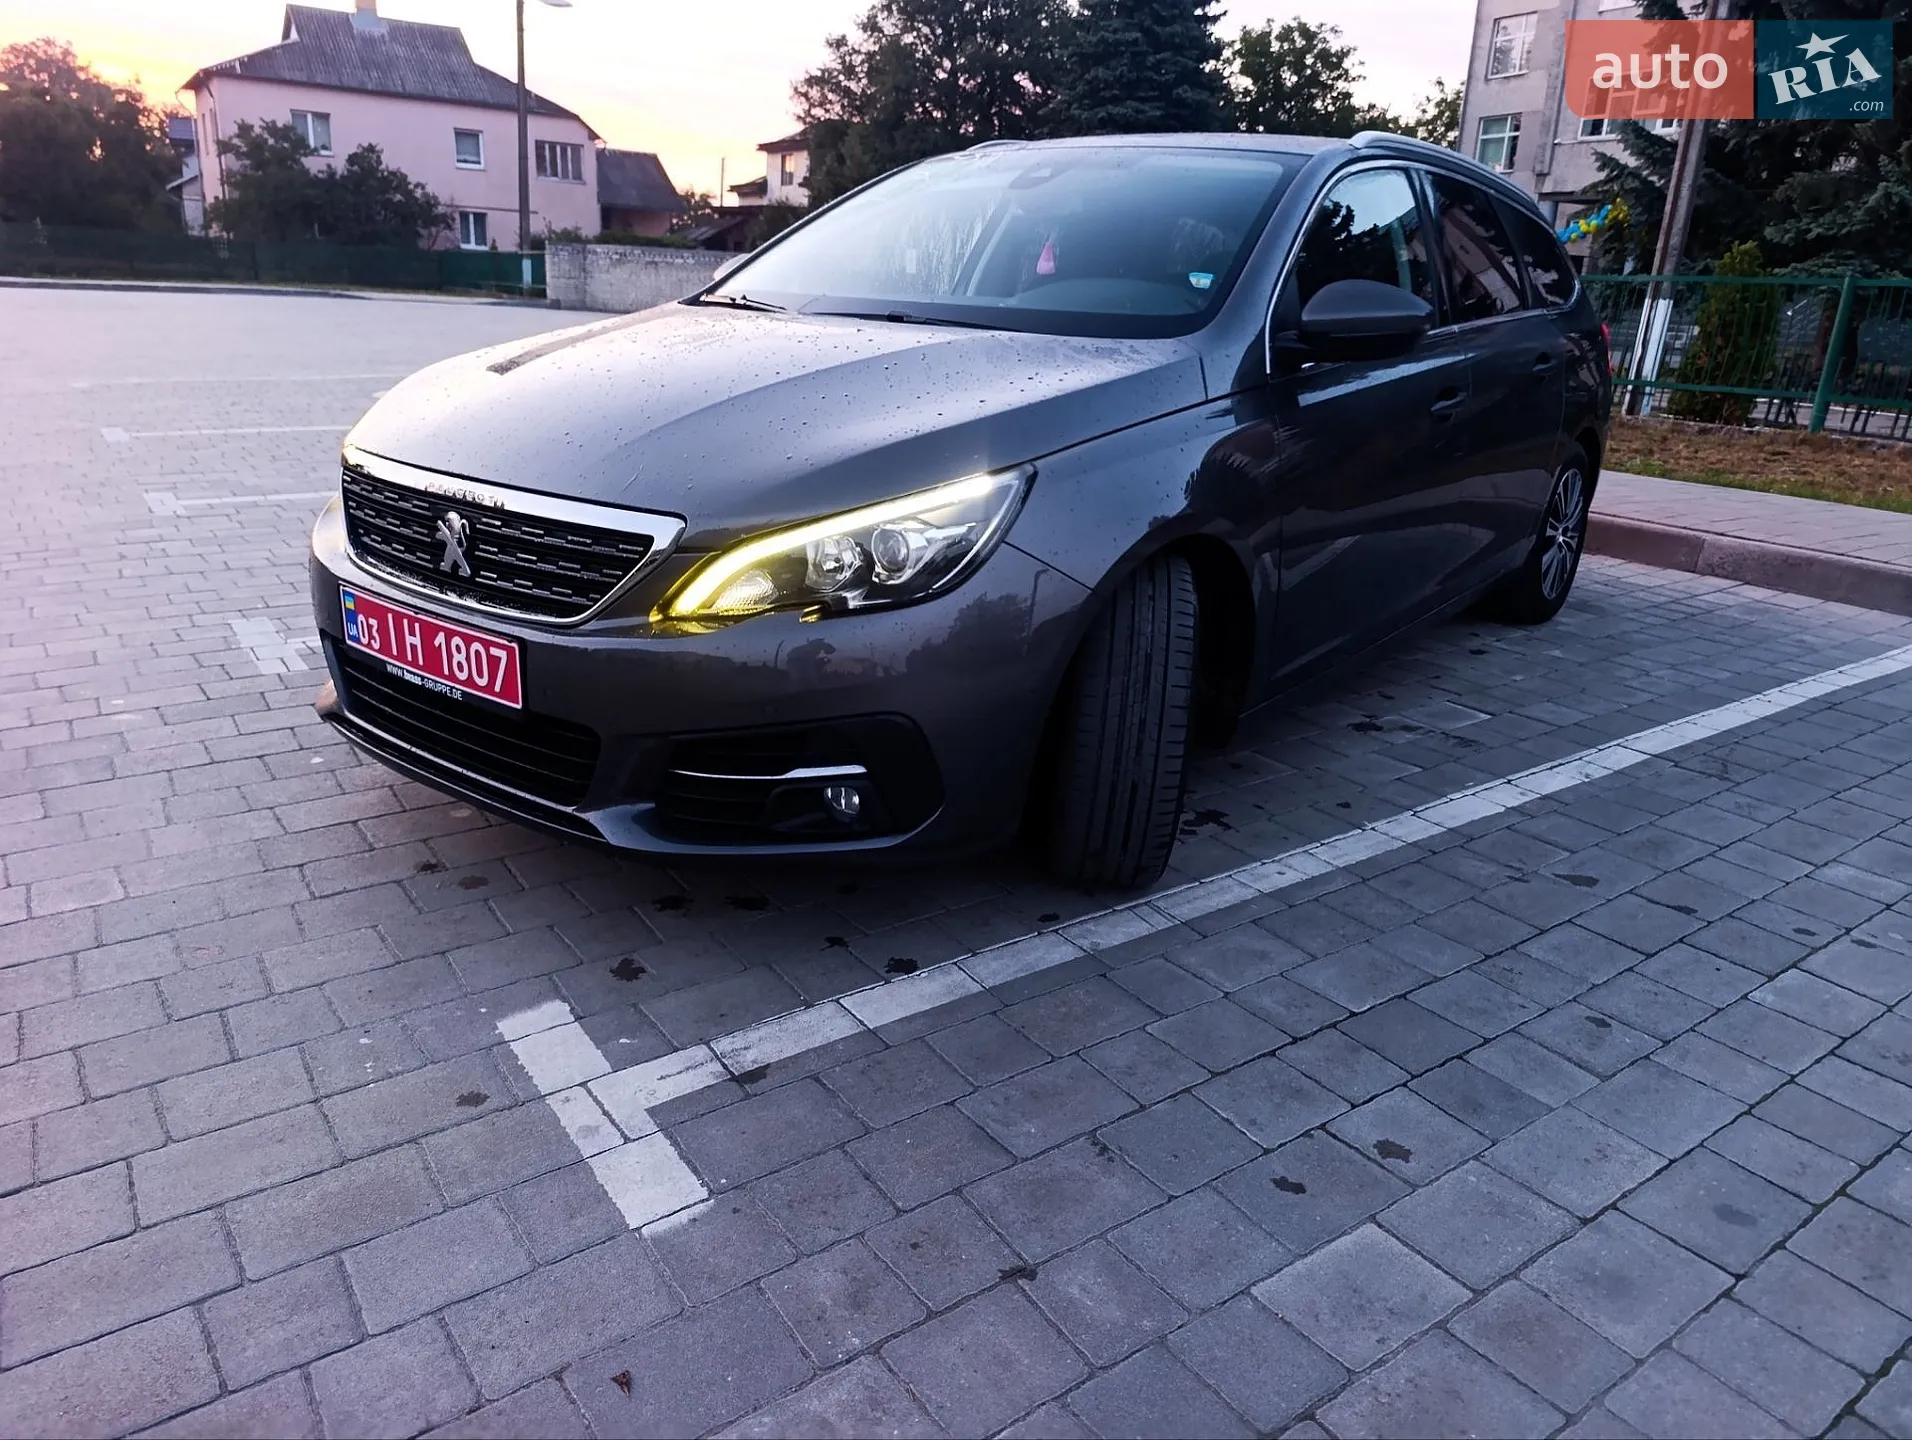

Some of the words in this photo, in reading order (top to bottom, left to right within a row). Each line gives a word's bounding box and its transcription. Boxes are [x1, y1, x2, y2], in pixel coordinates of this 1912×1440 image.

[347, 623, 359, 638] UA
[357, 613, 380, 651] 03
[433, 631, 508, 693] 1807
